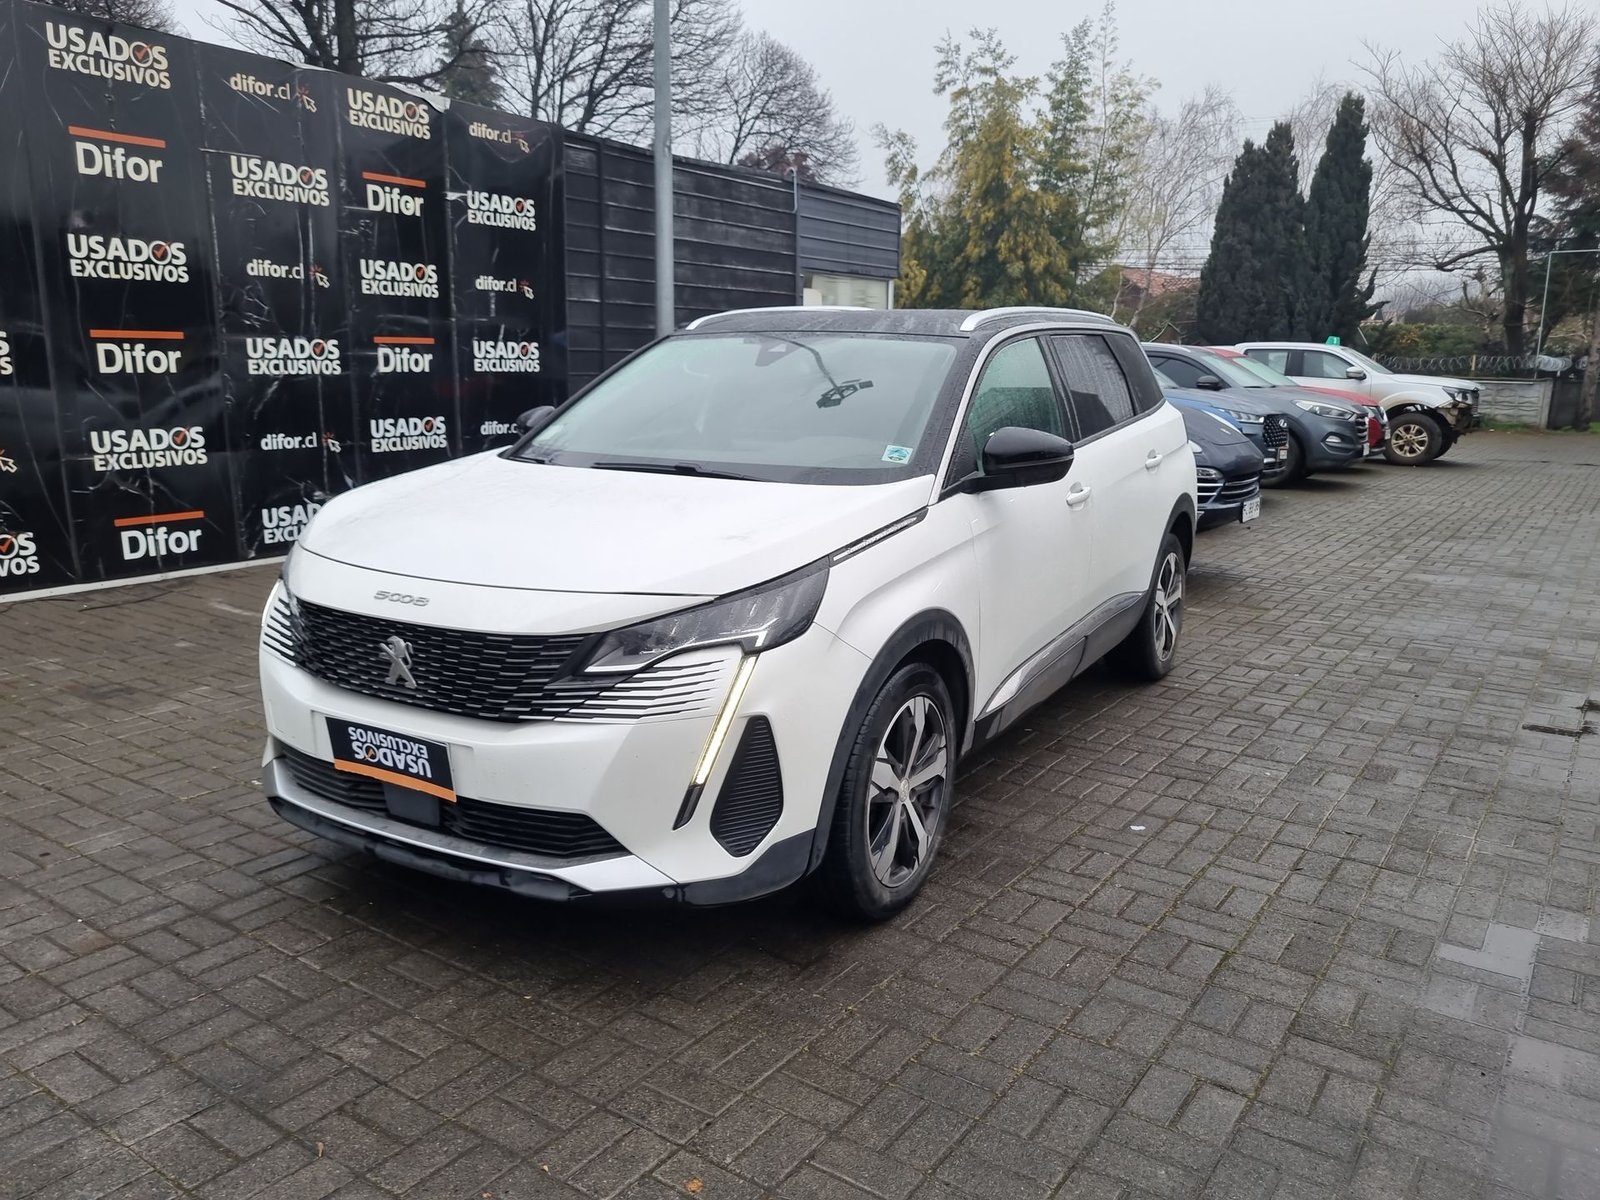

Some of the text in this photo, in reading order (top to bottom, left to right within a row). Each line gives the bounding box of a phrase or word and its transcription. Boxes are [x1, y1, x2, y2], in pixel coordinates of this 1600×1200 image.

[45, 21, 169, 71] USADOS
[48, 48, 172, 90] EXCLUSIVOS
[229, 72, 291, 101] difor.cl
[347, 87, 430, 124] USADOS
[348, 109, 431, 140] EXCLUSIVOS
[468, 121, 512, 144] difor.cl
[75, 141, 163, 183] Difor
[230, 155, 328, 190] USADOS
[232, 178, 330, 207] EXCLUSIVOS
[366, 183, 424, 217] Difor
[466, 190, 536, 217] USADOS
[467, 208, 536, 231] EXCLUSIVOS
[67, 233, 187, 266] USADOS
[70, 258, 189, 284] EXCLUSIVOS
[246, 258, 304, 280] difor.cl
[359, 258, 438, 284] USADOS
[361, 279, 439, 299] EXCLUSIVOS
[475, 275, 517, 293] difor.cl
[96, 342, 182, 374] Difor
[246, 337, 340, 360] USADOS
[377, 347, 433, 373] Difor
[472, 339, 540, 360] USADOS
[247, 359, 342, 375] EXCLUSIVOS
[473, 358, 540, 373] EXCLUSIVOS
[90, 426, 206, 453] USADOS
[370, 416, 447, 438] USADOS
[480, 420, 518, 435] difor.c
[260, 432, 317, 451] difor.cl
[371, 434, 447, 453] EXCLUSIVOS
[93, 449, 208, 472] EXCLUSIVOS
[261, 503, 322, 529] USAD
[120, 528, 203, 561] Difor
[0, 555, 40, 577] VOS
[348, 726, 429, 760] EXCLUSIVOS
[351, 741, 433, 778] USADOS
